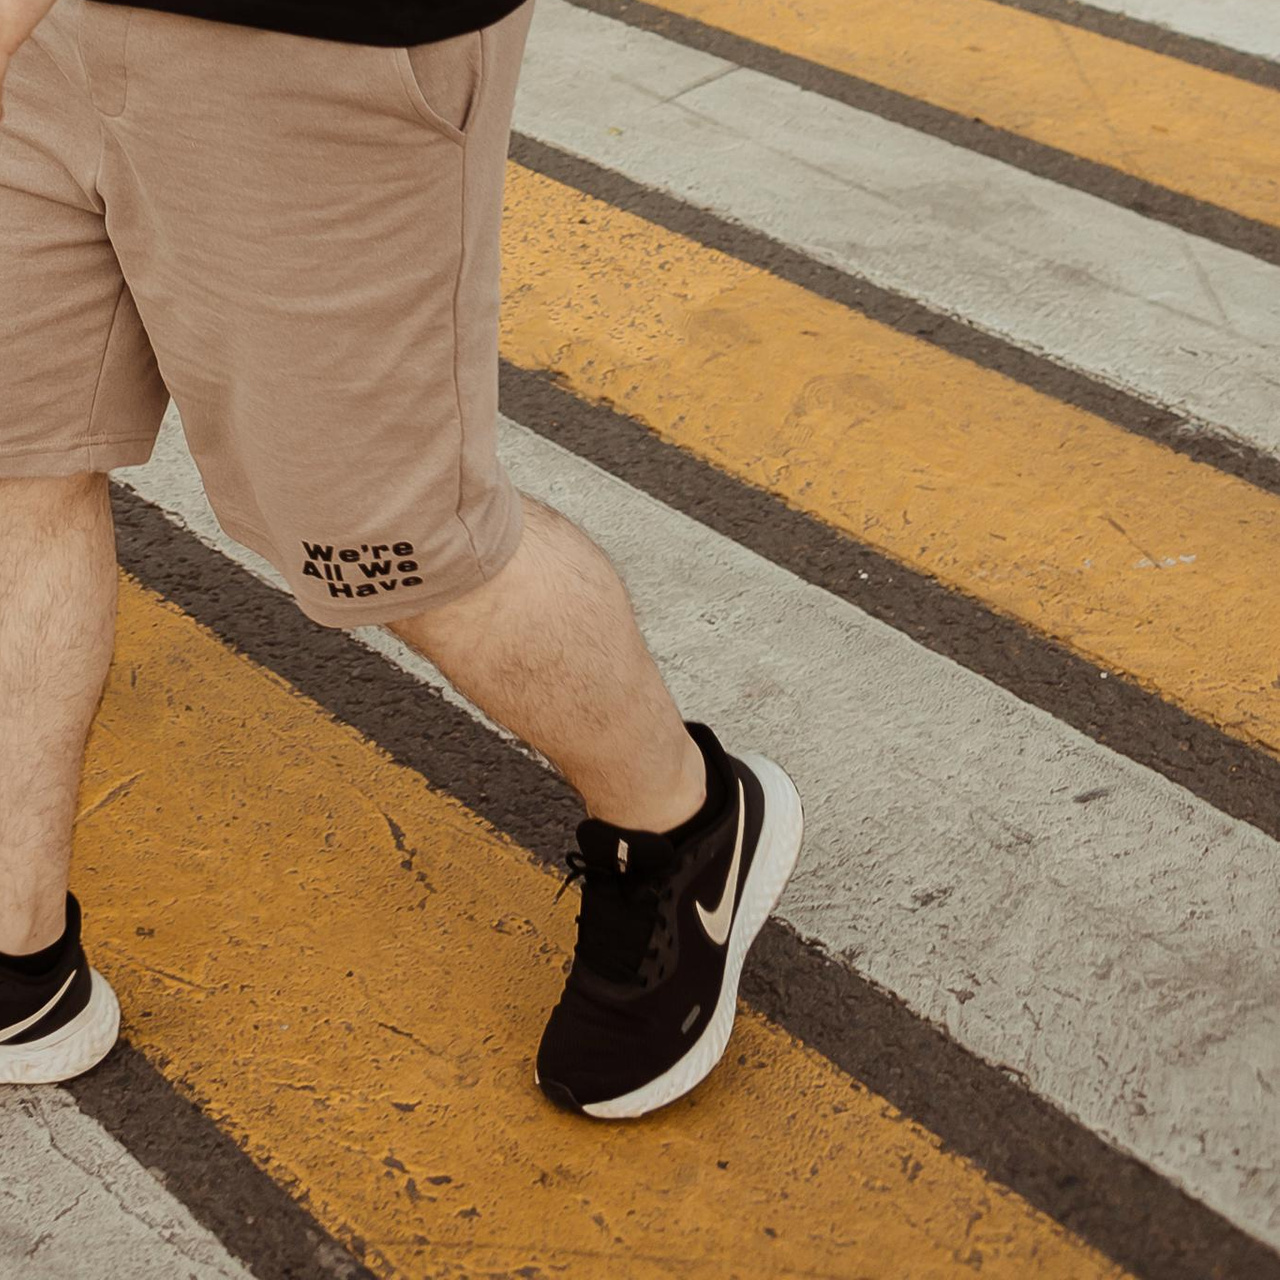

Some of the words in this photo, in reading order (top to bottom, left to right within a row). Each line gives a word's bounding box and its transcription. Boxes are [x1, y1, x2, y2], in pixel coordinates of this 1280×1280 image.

[302, 541, 413, 562] We're
[302, 560, 344, 581] All
[358, 560, 418, 578] We
[328, 576, 423, 598] Have
